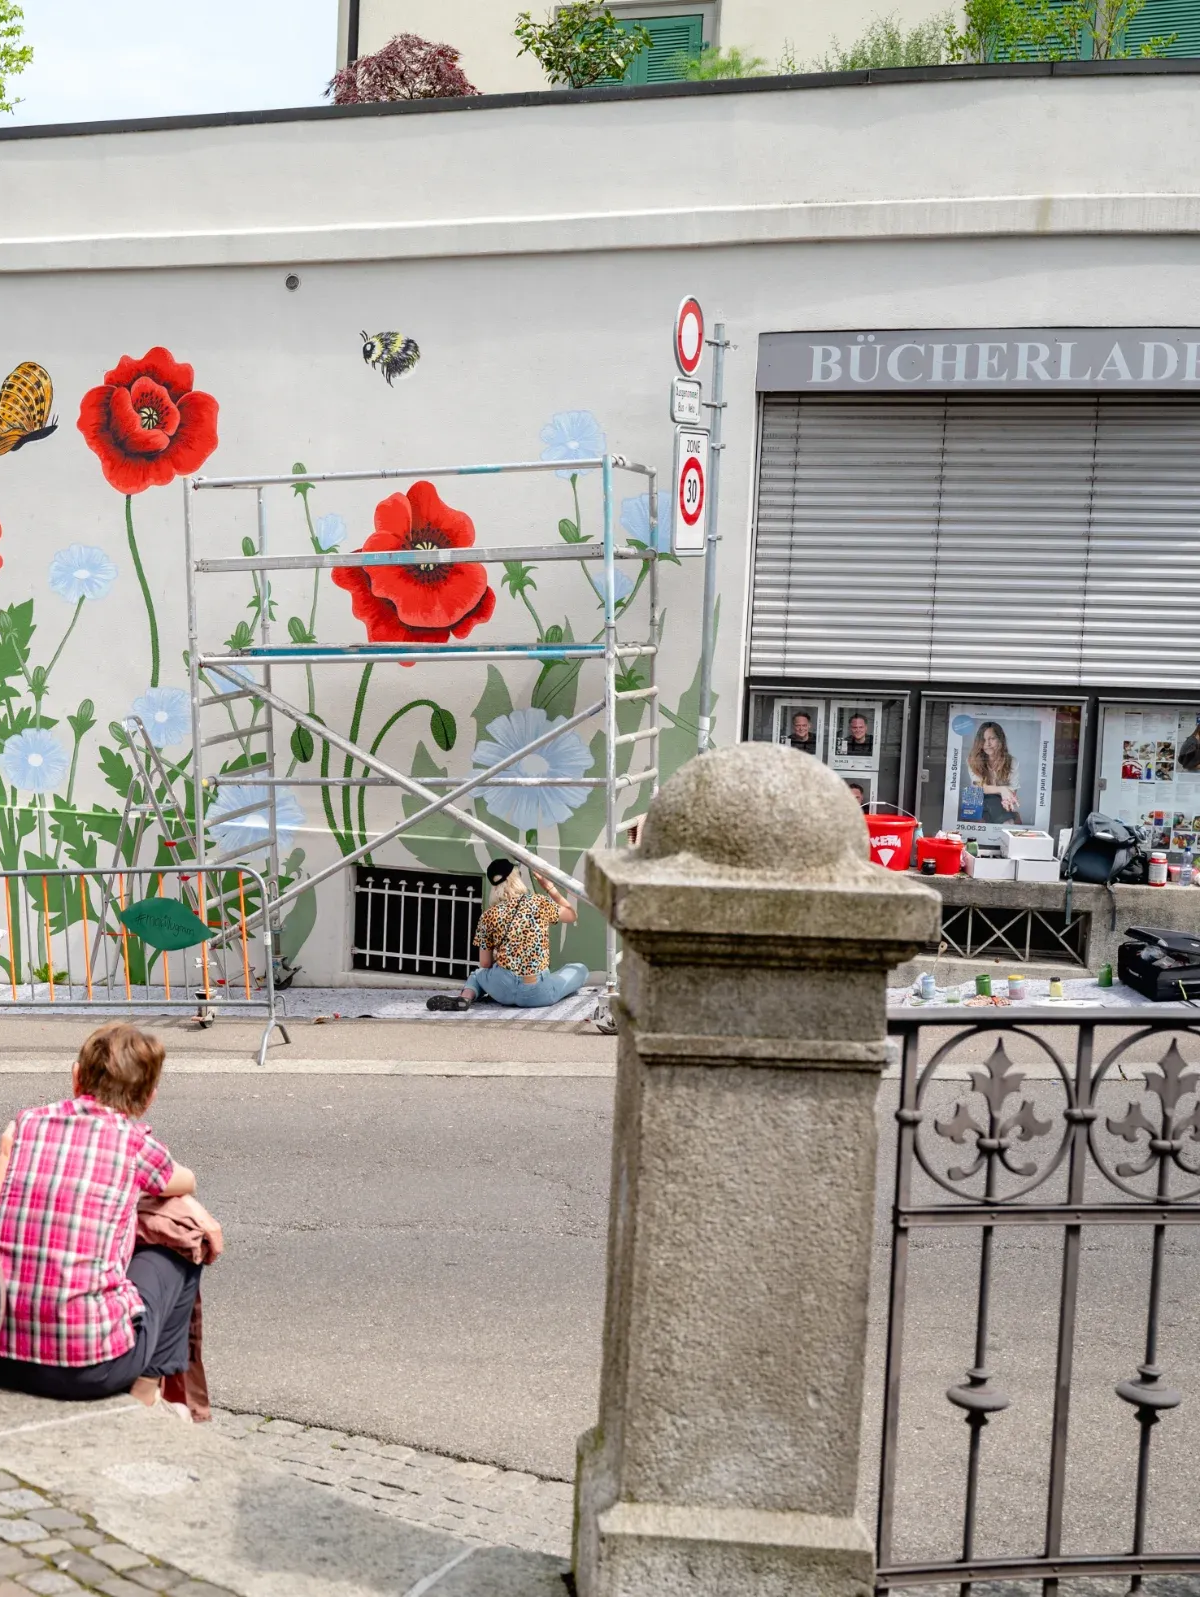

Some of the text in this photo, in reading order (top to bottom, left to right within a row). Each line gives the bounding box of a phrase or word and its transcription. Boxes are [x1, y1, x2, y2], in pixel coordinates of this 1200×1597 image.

[686, 439, 701, 454] ZONE
[686, 479, 698, 503] 30
[1041, 740, 1049, 762] Immer
[950, 748, 959, 791] Tabea Steiner
[956, 824, 987, 832] 29.06.23
